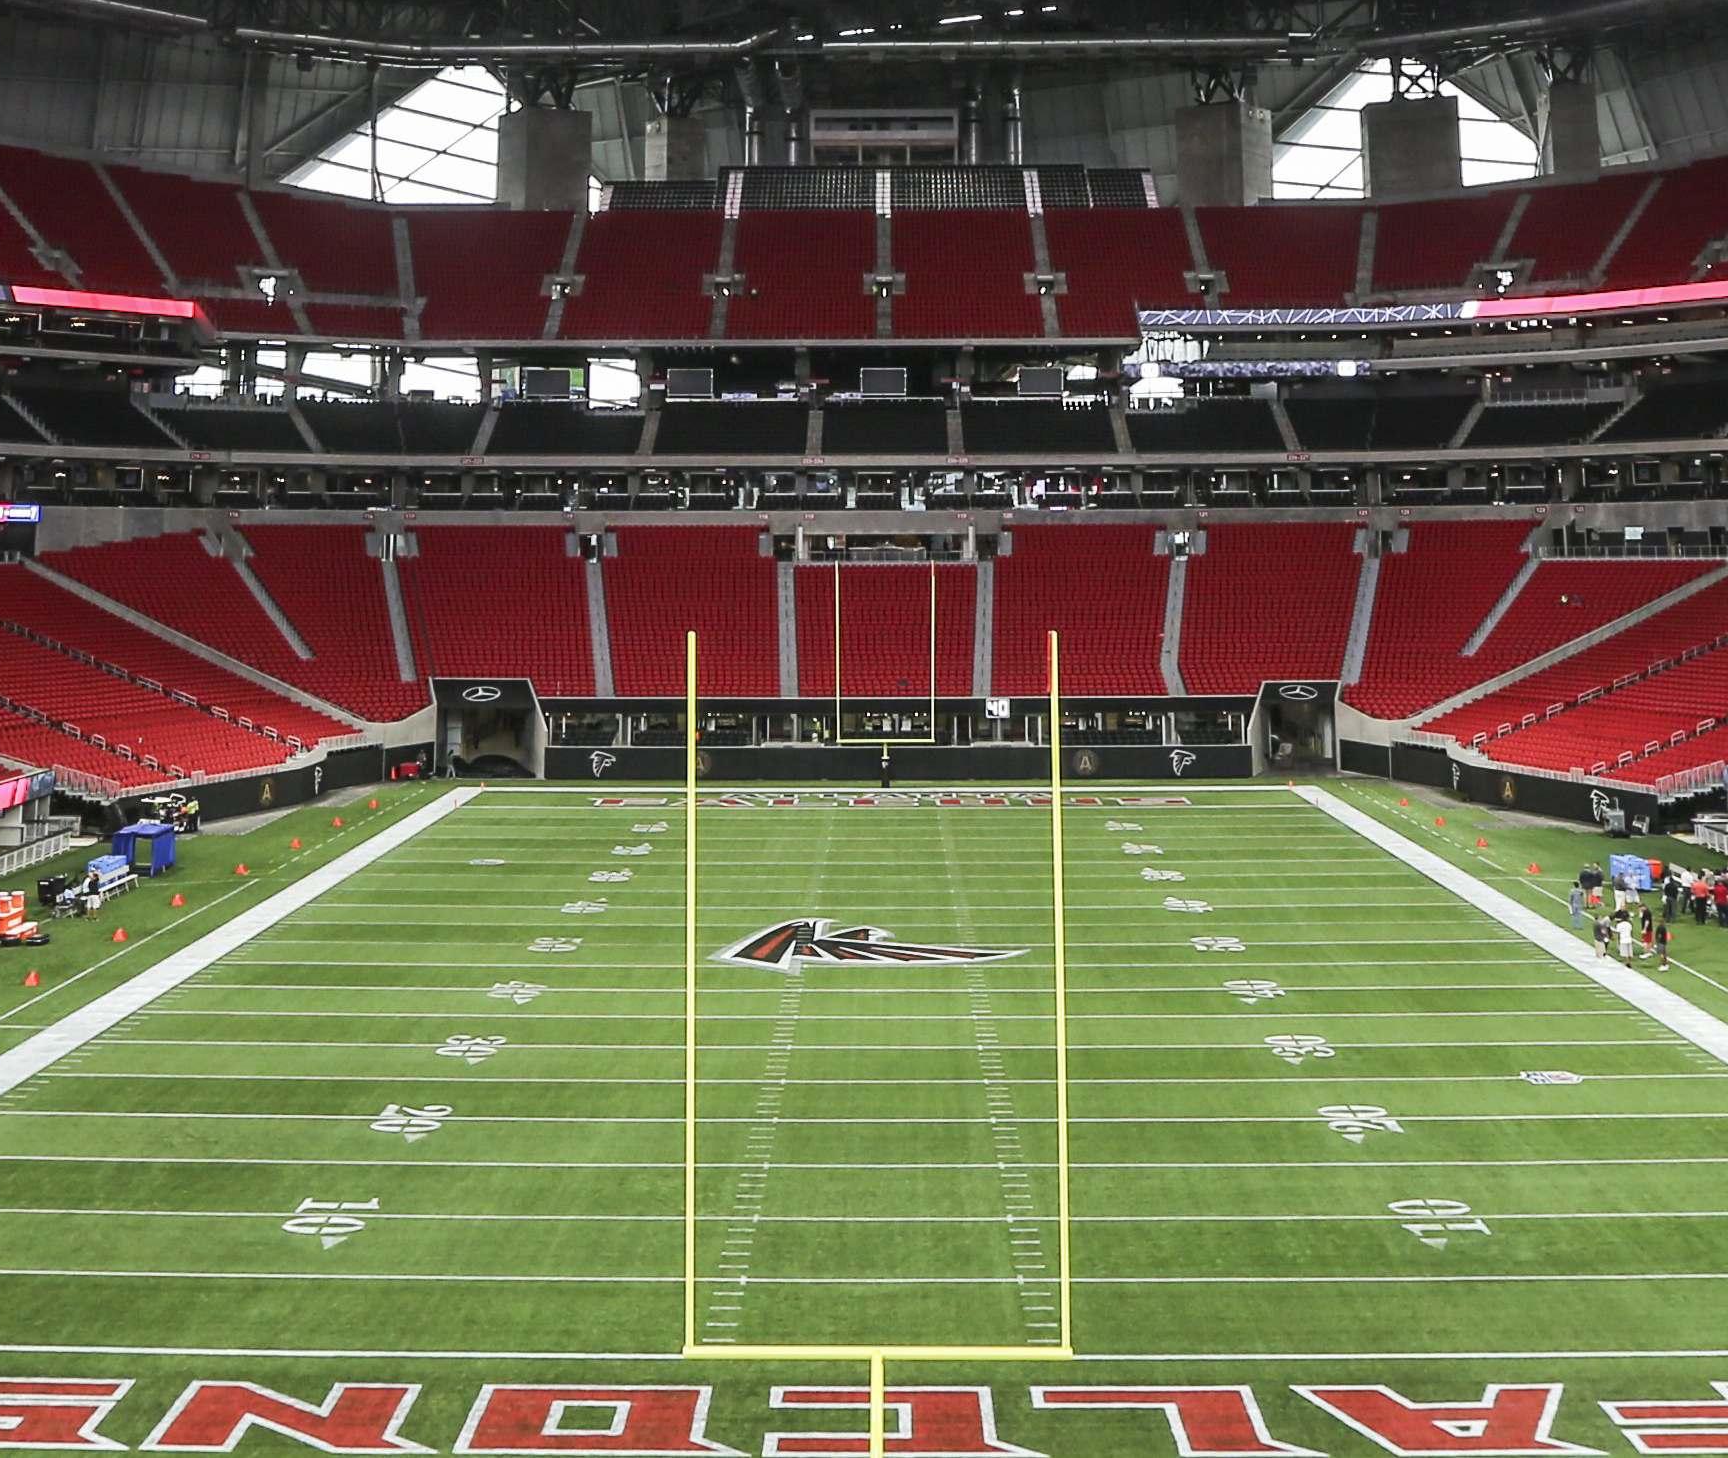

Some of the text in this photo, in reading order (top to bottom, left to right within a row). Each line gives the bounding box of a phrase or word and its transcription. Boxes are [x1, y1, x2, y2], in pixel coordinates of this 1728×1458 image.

[987, 699, 1008, 717] 40
[435, 1034, 507, 1057] 30
[1263, 1034, 1336, 1057] 30
[369, 1103, 454, 1134] 20
[1317, 1104, 1406, 1134] 20
[281, 1196, 381, 1235] 10
[1387, 1199, 1493, 1236] 10
